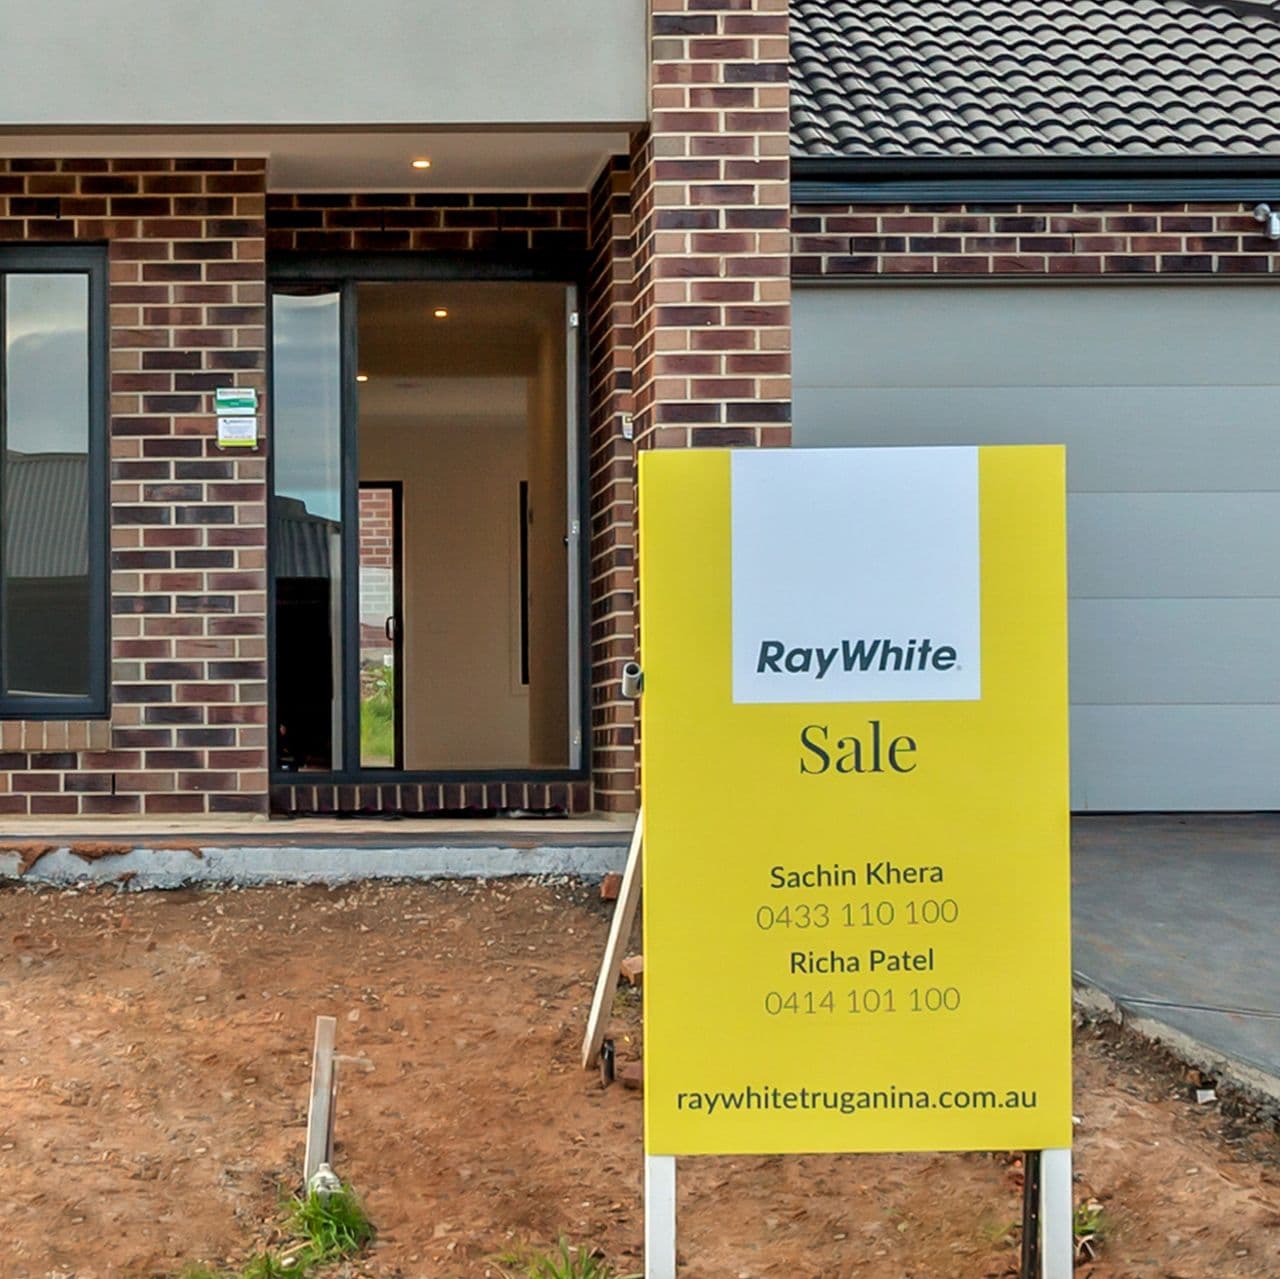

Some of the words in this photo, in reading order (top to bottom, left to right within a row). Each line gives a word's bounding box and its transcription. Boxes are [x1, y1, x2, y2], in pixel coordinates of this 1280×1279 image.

[799, 720, 917, 775] Sale
[770, 863, 857, 889] Sachin
[866, 861, 944, 886] Khera
[756, 903, 830, 930] 0433
[841, 901, 895, 927] 110
[905, 899, 959, 925] 100
[790, 949, 860, 975] Richa
[869, 947, 934, 973] Patel
[764, 990, 835, 1016] 0414
[847, 988, 897, 1014] 101
[910, 987, 961, 1013] 100
[676, 1082, 1038, 1115] raywhitetruganina.com.au
